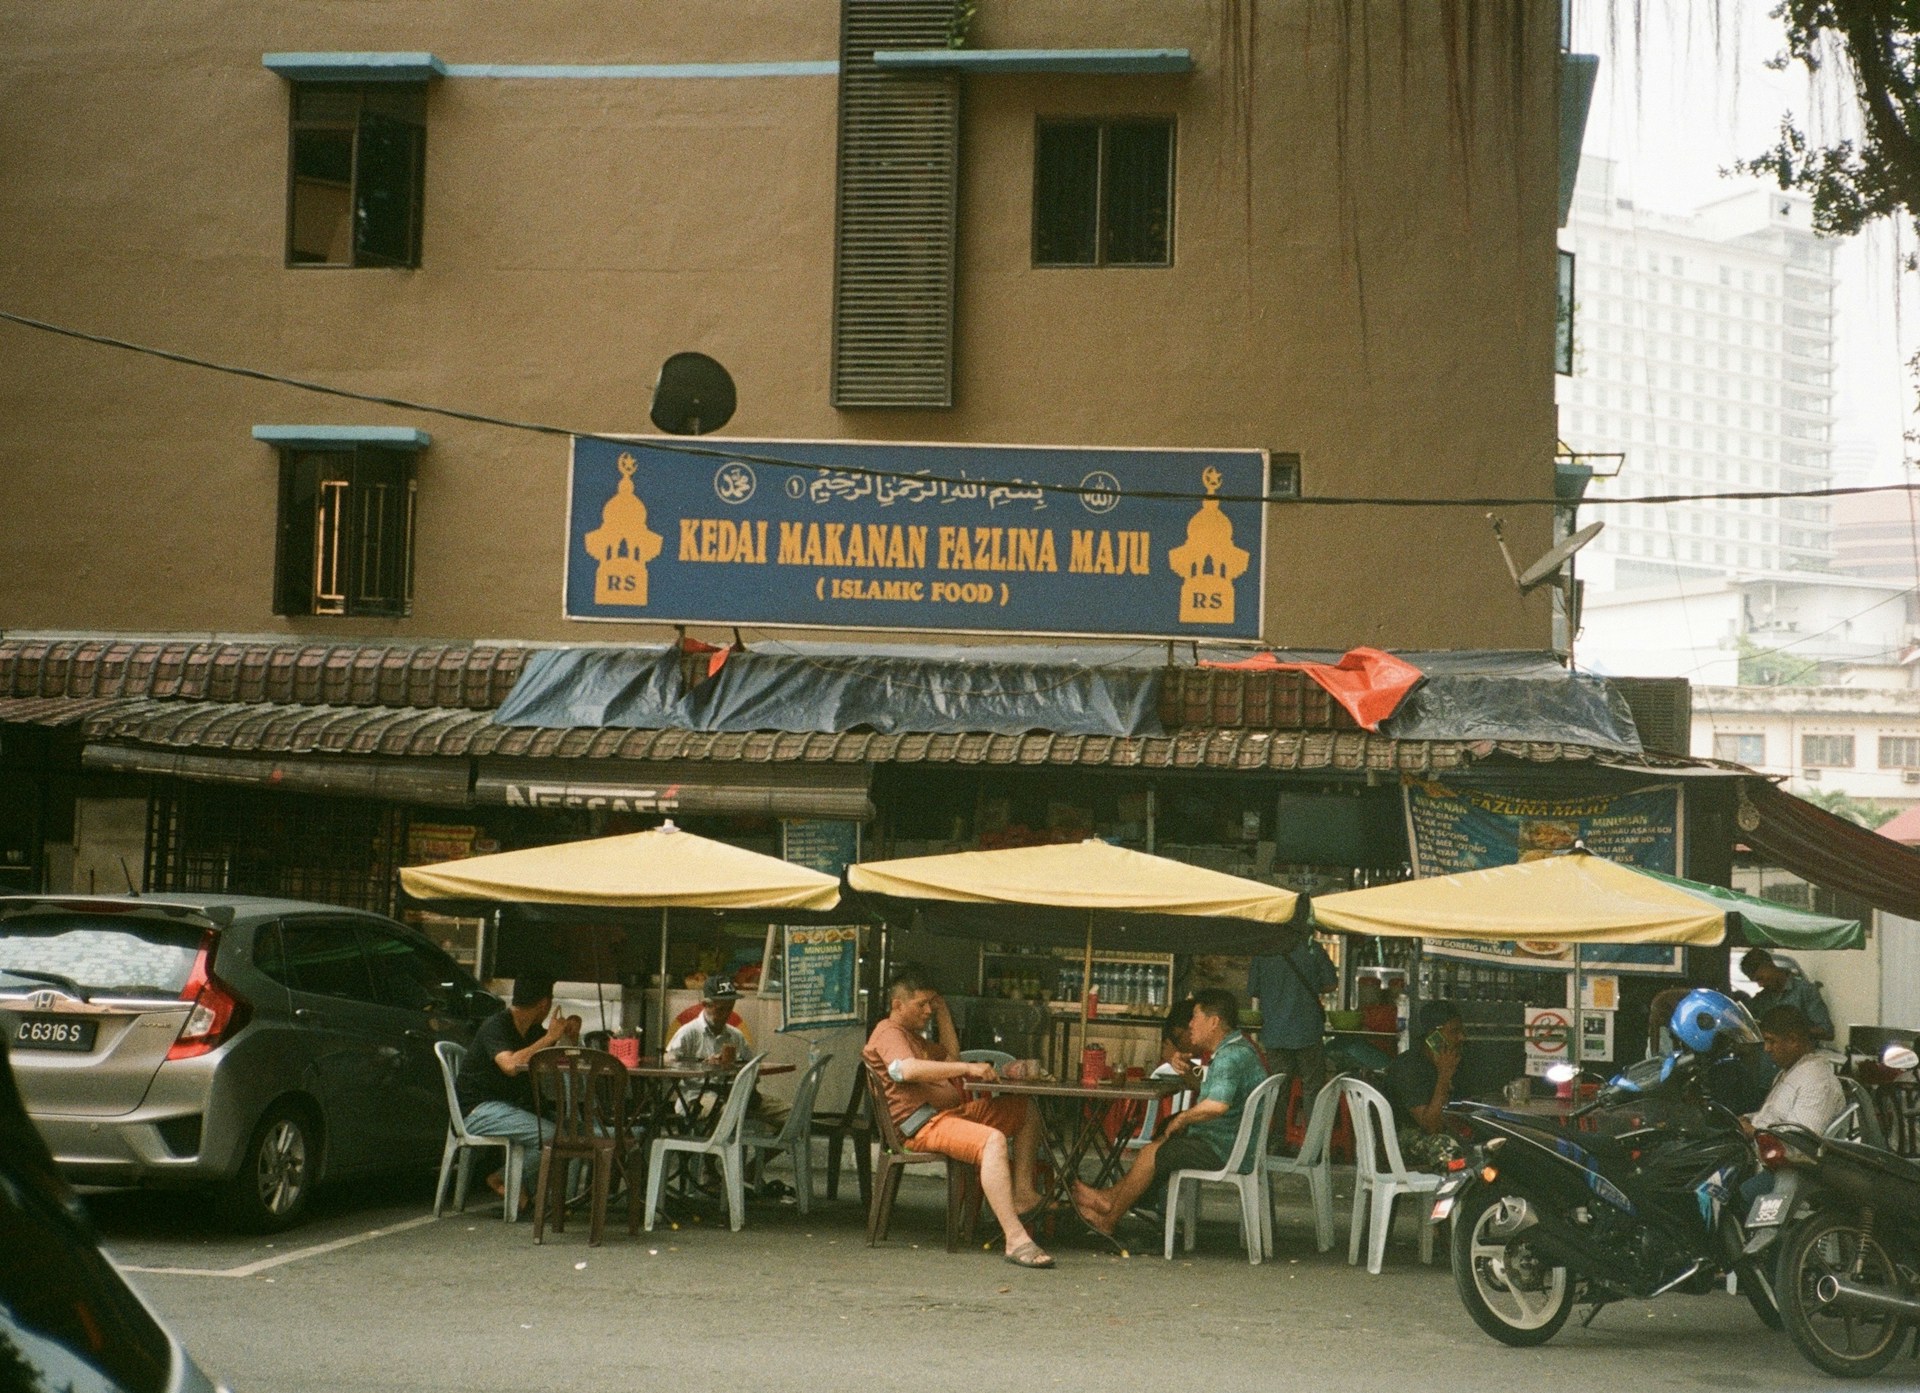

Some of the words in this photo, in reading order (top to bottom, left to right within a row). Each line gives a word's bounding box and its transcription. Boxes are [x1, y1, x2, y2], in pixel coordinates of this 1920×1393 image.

[678, 519, 768, 564] KEDAI
[778, 521, 928, 569] MAKANAN
[937, 526, 1058, 573] FAZLINA
[1068, 529, 1150, 575] MAJU
[607, 575, 637, 592] RS
[831, 579, 924, 602] ISLAMIC
[930, 582, 994, 604] FOOD
[1192, 592, 1223, 609] RS
[31, 1023, 68, 1041] 6316
[69, 1024, 81, 1042] S
